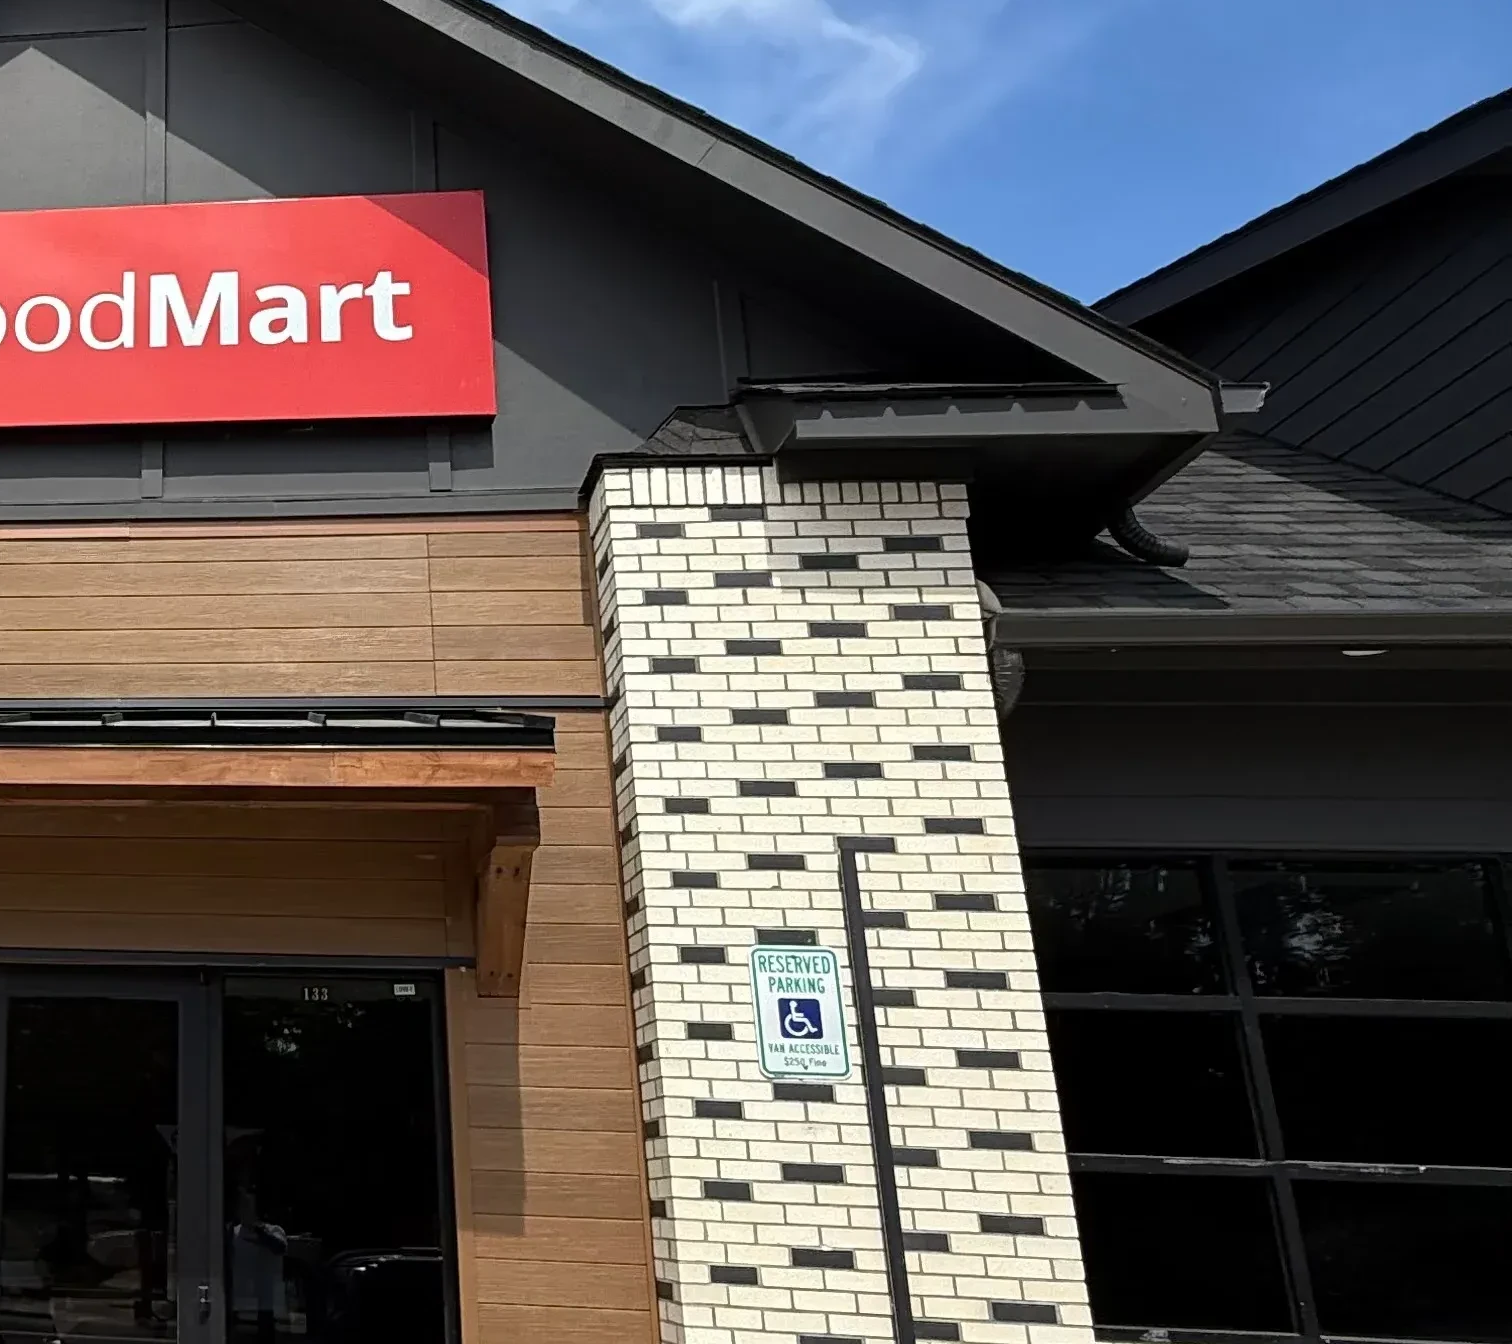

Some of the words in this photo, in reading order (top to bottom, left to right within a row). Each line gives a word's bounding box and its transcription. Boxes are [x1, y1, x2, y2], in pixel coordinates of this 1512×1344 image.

[758, 955, 831, 974] RESERVED
[768, 977, 826, 994] PARKING
[303, 987, 329, 1001] 133
[768, 1042, 786, 1053] VAN
[789, 1043, 840, 1055] ACCESSIBLE
[784, 1056, 805, 1067] $250
[808, 1057, 827, 1067] Fine
